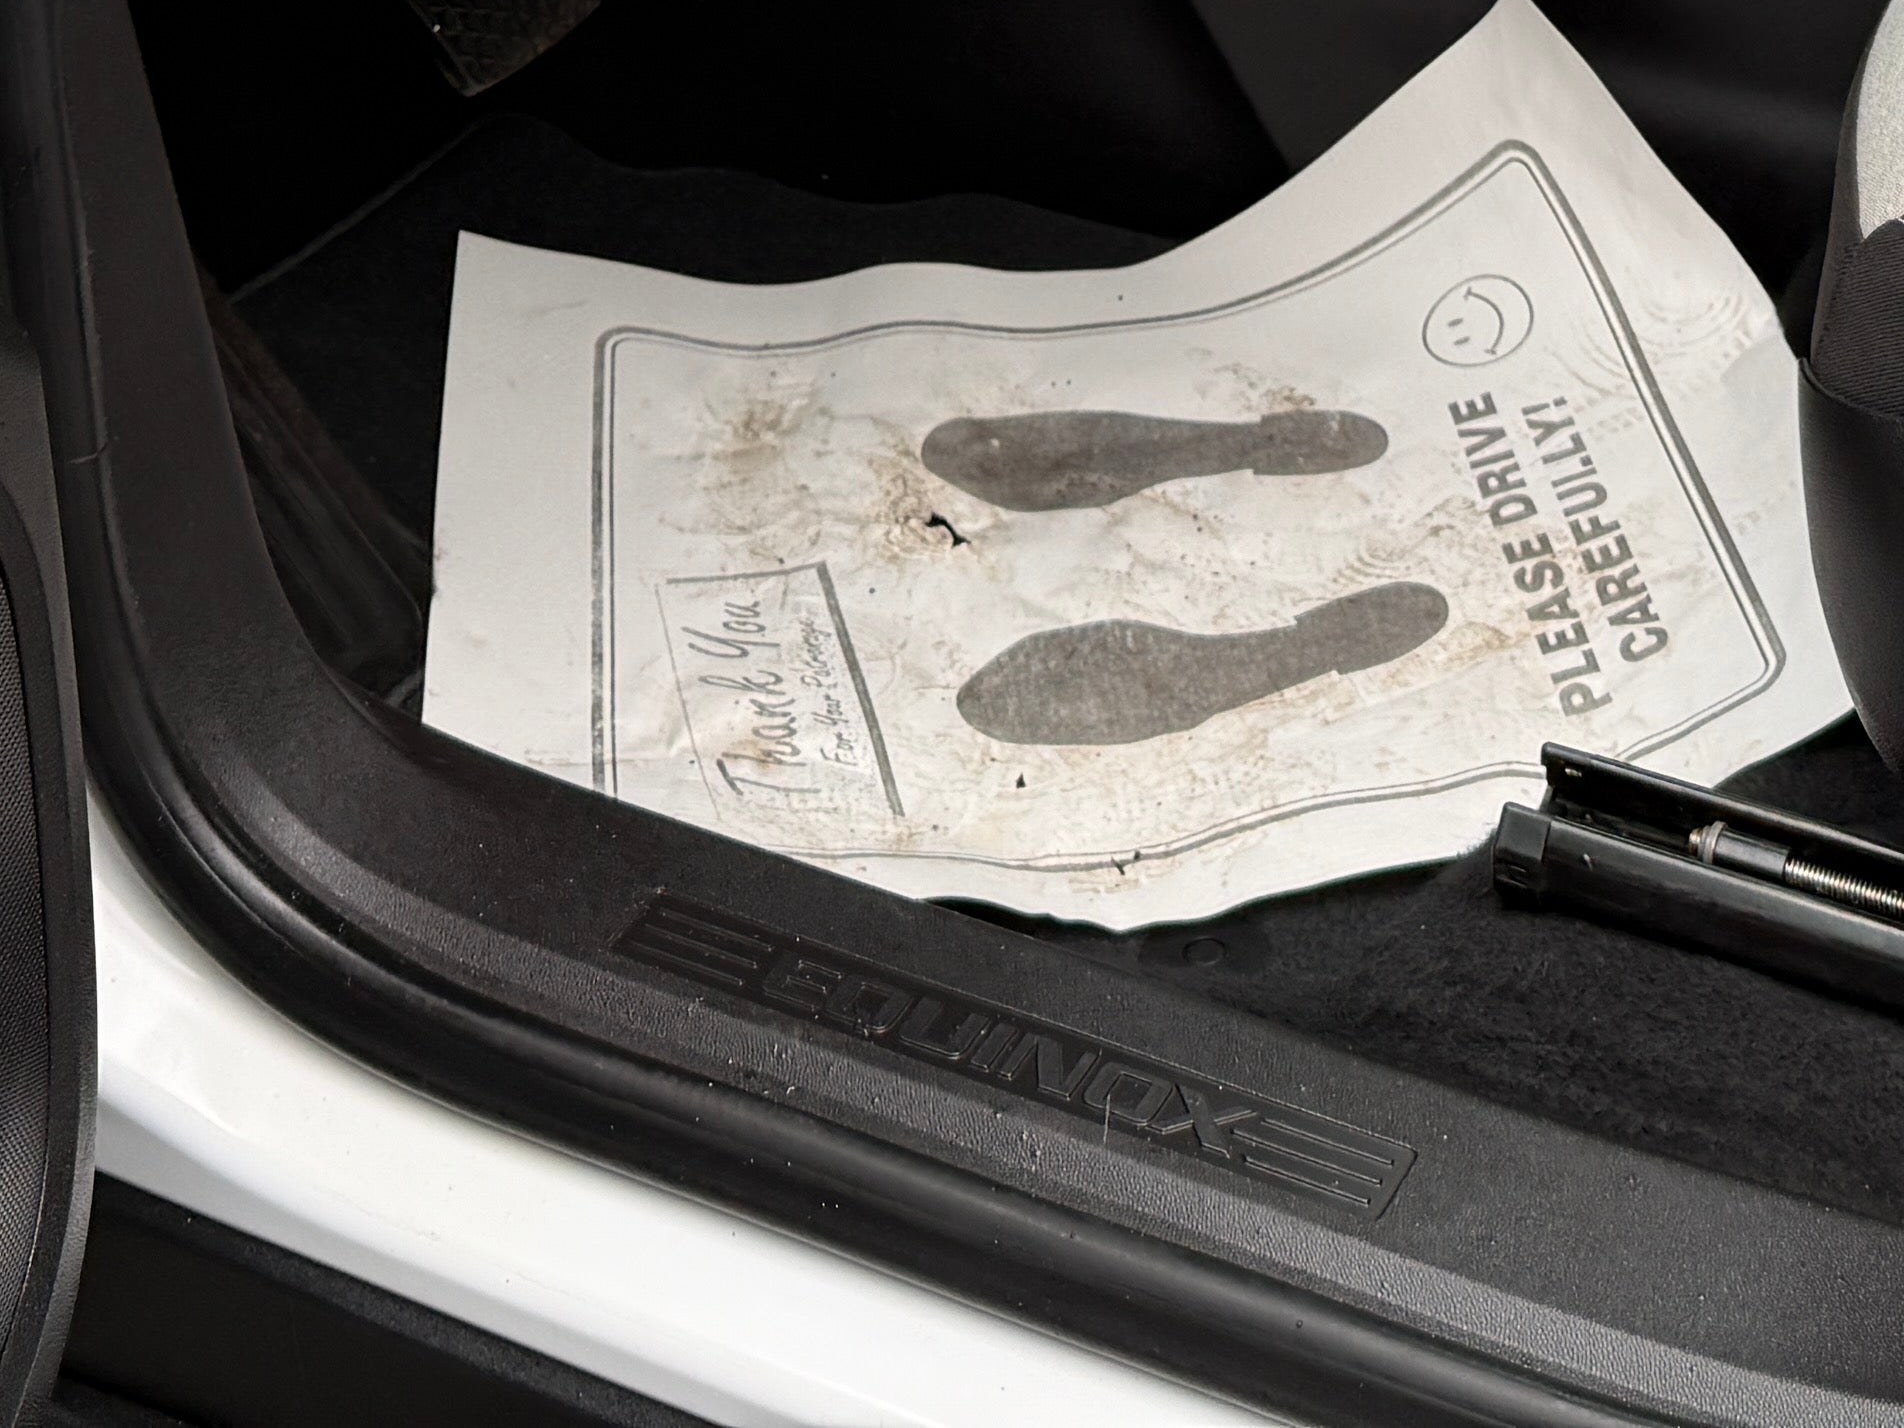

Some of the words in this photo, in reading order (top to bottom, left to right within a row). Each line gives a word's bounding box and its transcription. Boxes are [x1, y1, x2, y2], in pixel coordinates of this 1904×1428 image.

[1447, 390, 1539, 528] DRIVE
[1521, 395, 1670, 664] CAREFULLY!
[681, 599, 782, 660] You
[1501, 531, 1614, 718] PLEASE
[697, 669, 823, 796] Thank
[819, 731, 859, 767] For
[760, 948, 1258, 1159] EQUINOX
